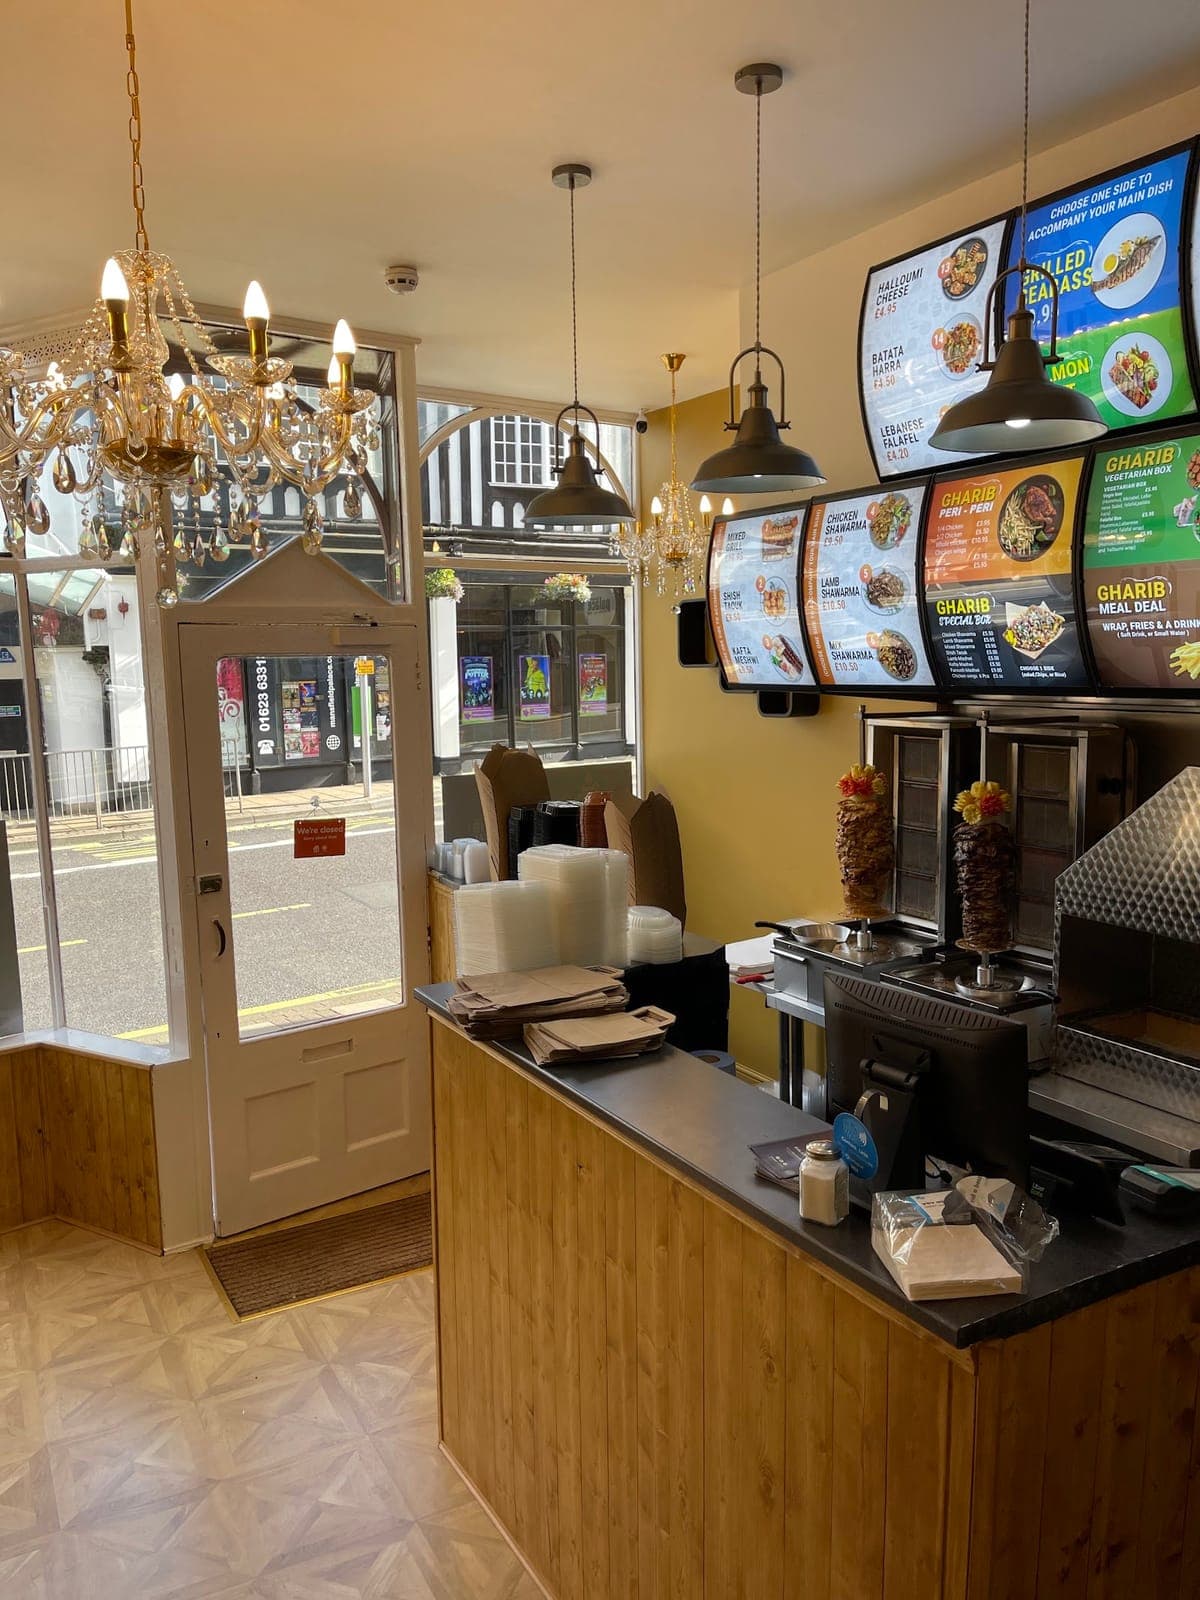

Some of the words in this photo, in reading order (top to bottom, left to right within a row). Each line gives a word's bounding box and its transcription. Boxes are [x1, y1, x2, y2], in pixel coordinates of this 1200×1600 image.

[1050, 196, 1091, 220] CHOOSE
[1090, 187, 1112, 204] ONE
[1113, 178, 1137, 196] SIDE
[1138, 172, 1152, 187] TO
[1028, 211, 1087, 242] ACCOMPANY
[1089, 202, 1116, 220] YOUR
[1118, 190, 1145, 209] MAIN
[1147, 179, 1174, 199] DISH
[878, 268, 924, 294] HALLOUMI
[876, 284, 909, 306] CHEESE
[874, 303, 897, 319] £4.95
[934, 334, 944, 345] 14
[872, 345, 904, 365] BATATA
[872, 360, 902, 377] HARRA
[874, 375, 896, 391] £4.50
[880, 418, 925, 438] LEBANESE
[883, 433, 920, 449] FALAFEL
[887, 448, 909, 462] £4.20
[1106, 446, 1175, 473] GHARIB
[1104, 468, 1152, 482] VEGETARIAN
[1154, 464, 1172, 476] BOX
[942, 485, 997, 508] GHARIB
[827, 510, 859, 524] CHICKEN
[939, 506, 961, 518] PERI
[970, 502, 994, 514] PERI
[825, 520, 867, 535] SHAWARMA
[728, 532, 746, 541] MIXED
[822, 576, 840, 587] LAMB
[723, 591, 740, 600] SHISH
[822, 586, 860, 598] SHAWARMA
[1097, 581, 1166, 601] GHARIB
[936, 597, 990, 615] GHARIB
[1099, 602, 1132, 615] MEAL
[1134, 600, 1166, 613] DEAL
[939, 614, 973, 626] SPECIAL
[1102, 622, 1129, 632] WRAP,
[1130, 621, 1155, 630] FRIES
[1156, 620, 1164, 629] &
[1166, 620, 1173, 629] A
[732, 646, 752, 656] KAFTA
[831, 650, 874, 660] SHAWARMA
[734, 656, 760, 665] MESHWI
[835, 662, 858, 671] £10.50
[256, 656, 268, 690] 6331
[258, 692, 270, 732] 01623
[297, 826, 318, 834] We're
[320, 825, 344, 834] closed
